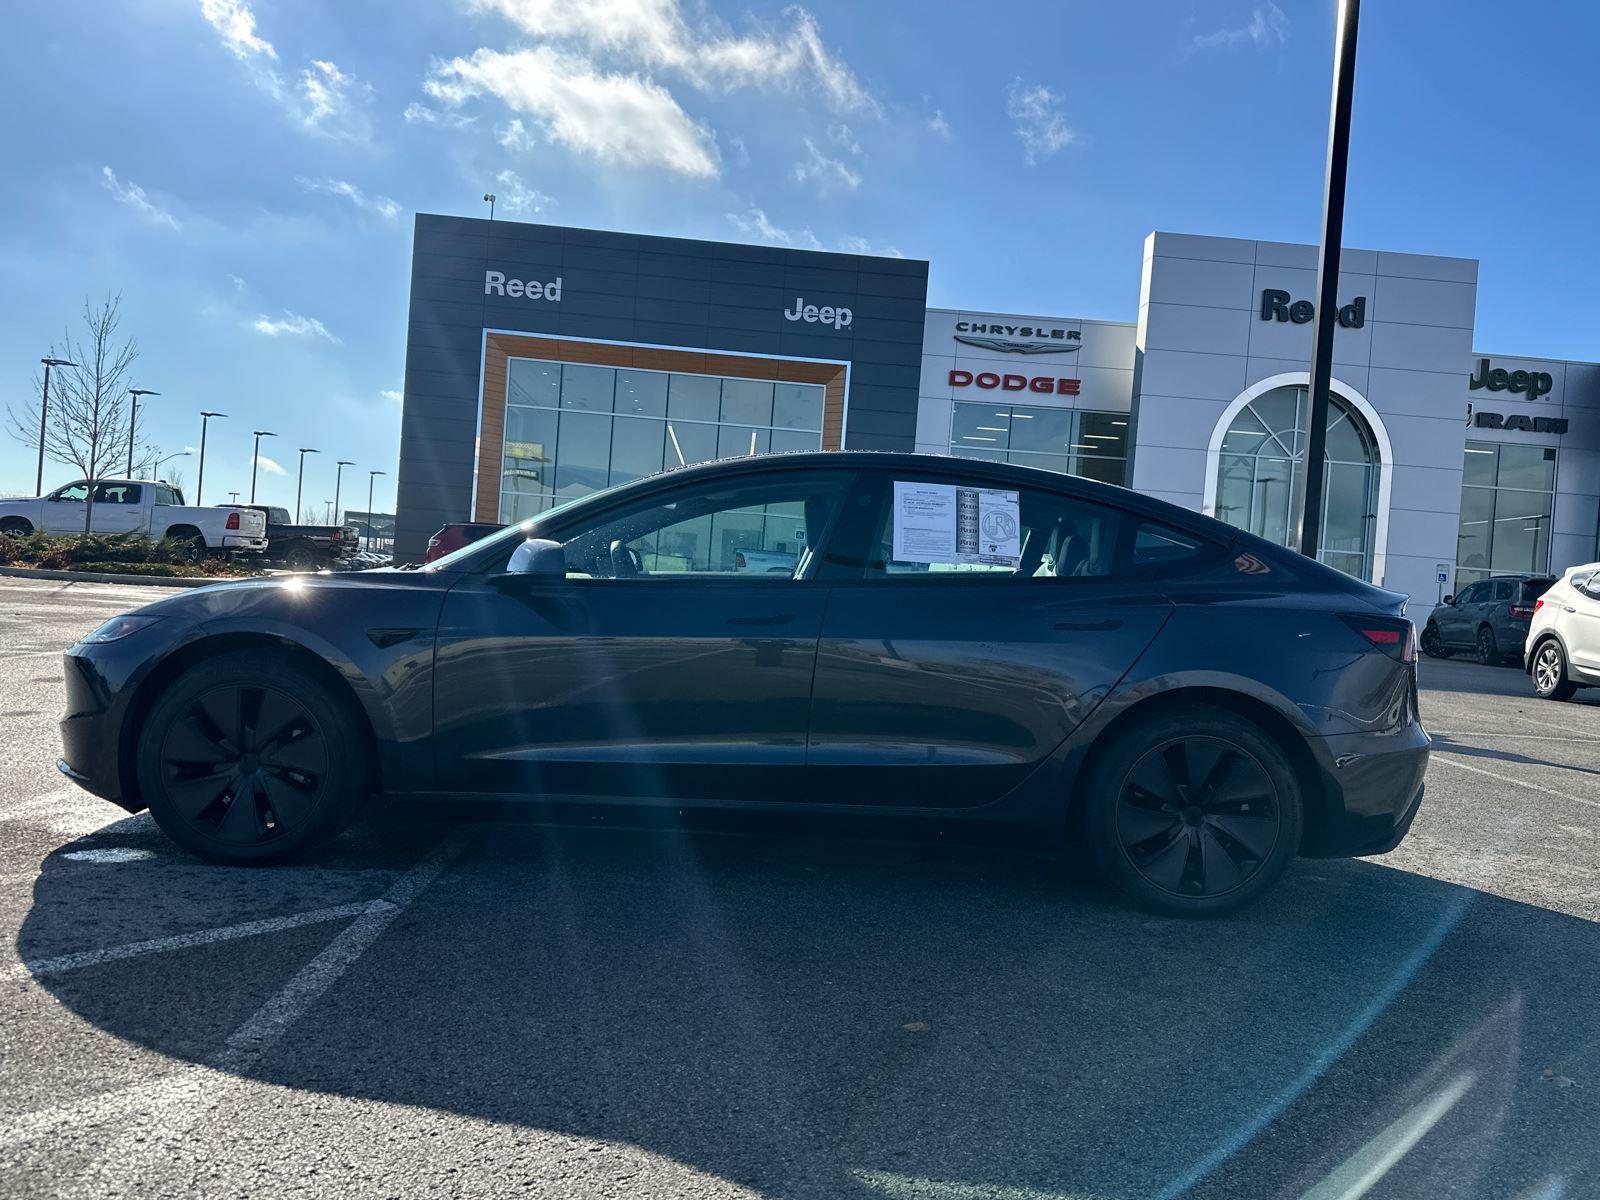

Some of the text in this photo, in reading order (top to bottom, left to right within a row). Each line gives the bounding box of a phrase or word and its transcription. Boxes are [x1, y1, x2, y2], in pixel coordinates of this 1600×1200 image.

[485, 270, 562, 301] Reed
[784, 298, 852, 329] Jeep
[1261, 288, 1366, 328] Red
[955, 322, 1082, 341] CHRYSLER
[948, 370, 1081, 395] DODGE
[1469, 359, 1552, 400] Jeep
[1475, 412, 1568, 434] RAM
